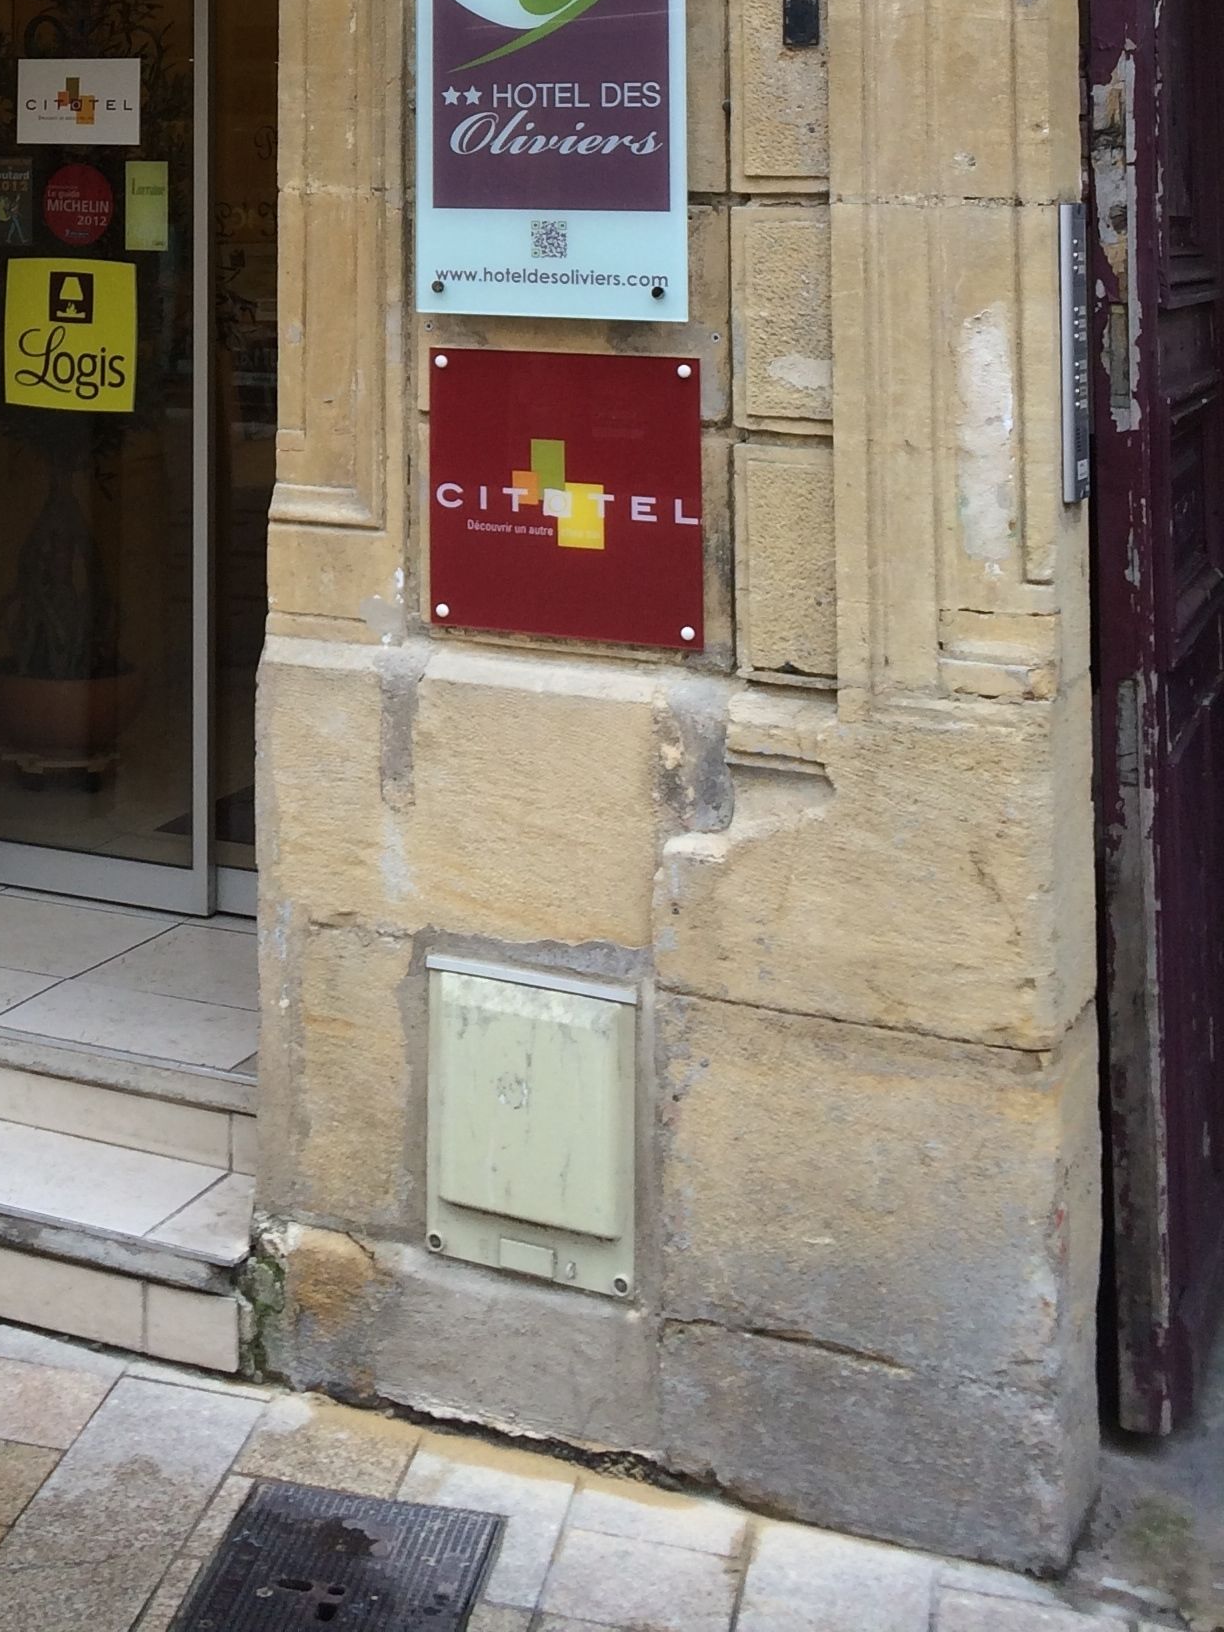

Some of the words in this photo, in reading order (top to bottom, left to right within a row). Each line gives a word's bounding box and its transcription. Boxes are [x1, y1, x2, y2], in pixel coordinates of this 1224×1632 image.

[25, 98, 133, 111] CITOTEL
[492, 81, 590, 109] HOTEL
[600, 81, 661, 109] DES
[449, 109, 664, 157] Oliviers
[47, 199, 110, 214] MICHELIN
[77, 215, 107, 227] 2012
[435, 266, 669, 288] www.hoteldesoliviers.com
[14, 325, 126, 401] Logis
[435, 482, 700, 526] CITOTEL
[466, 518, 513, 533] Découvrir
[514, 525, 527, 534] un
[528, 526, 554, 537] autre
